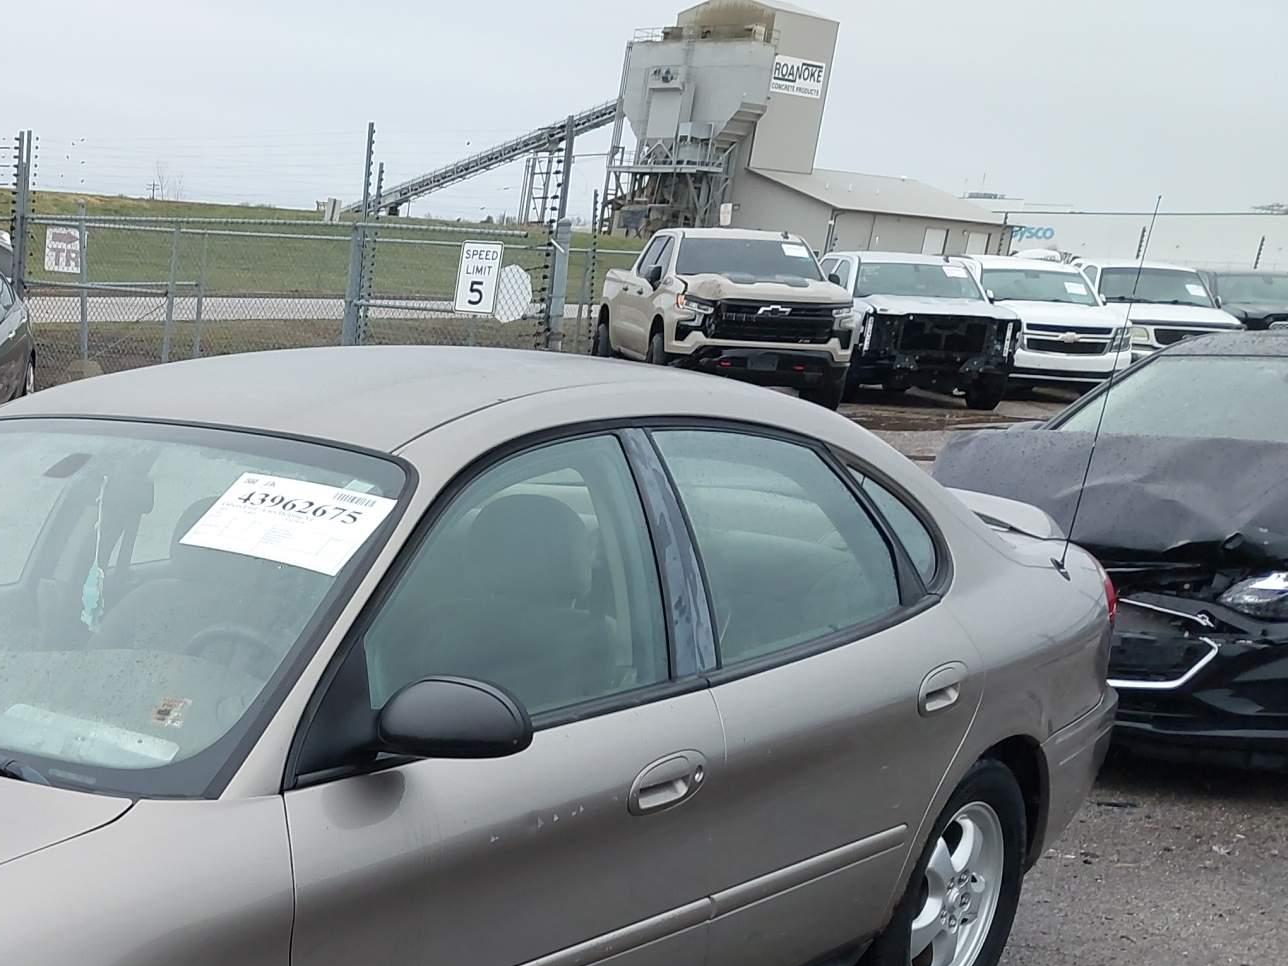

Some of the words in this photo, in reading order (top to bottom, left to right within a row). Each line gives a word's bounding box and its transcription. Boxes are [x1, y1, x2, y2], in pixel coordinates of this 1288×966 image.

[773, 62, 824, 83] ROANOKE
[465, 249, 499, 260] SPEED
[465, 264, 493, 276] LIMIT
[467, 280, 484, 305] 5
[238, 491, 364, 524] 43962675
